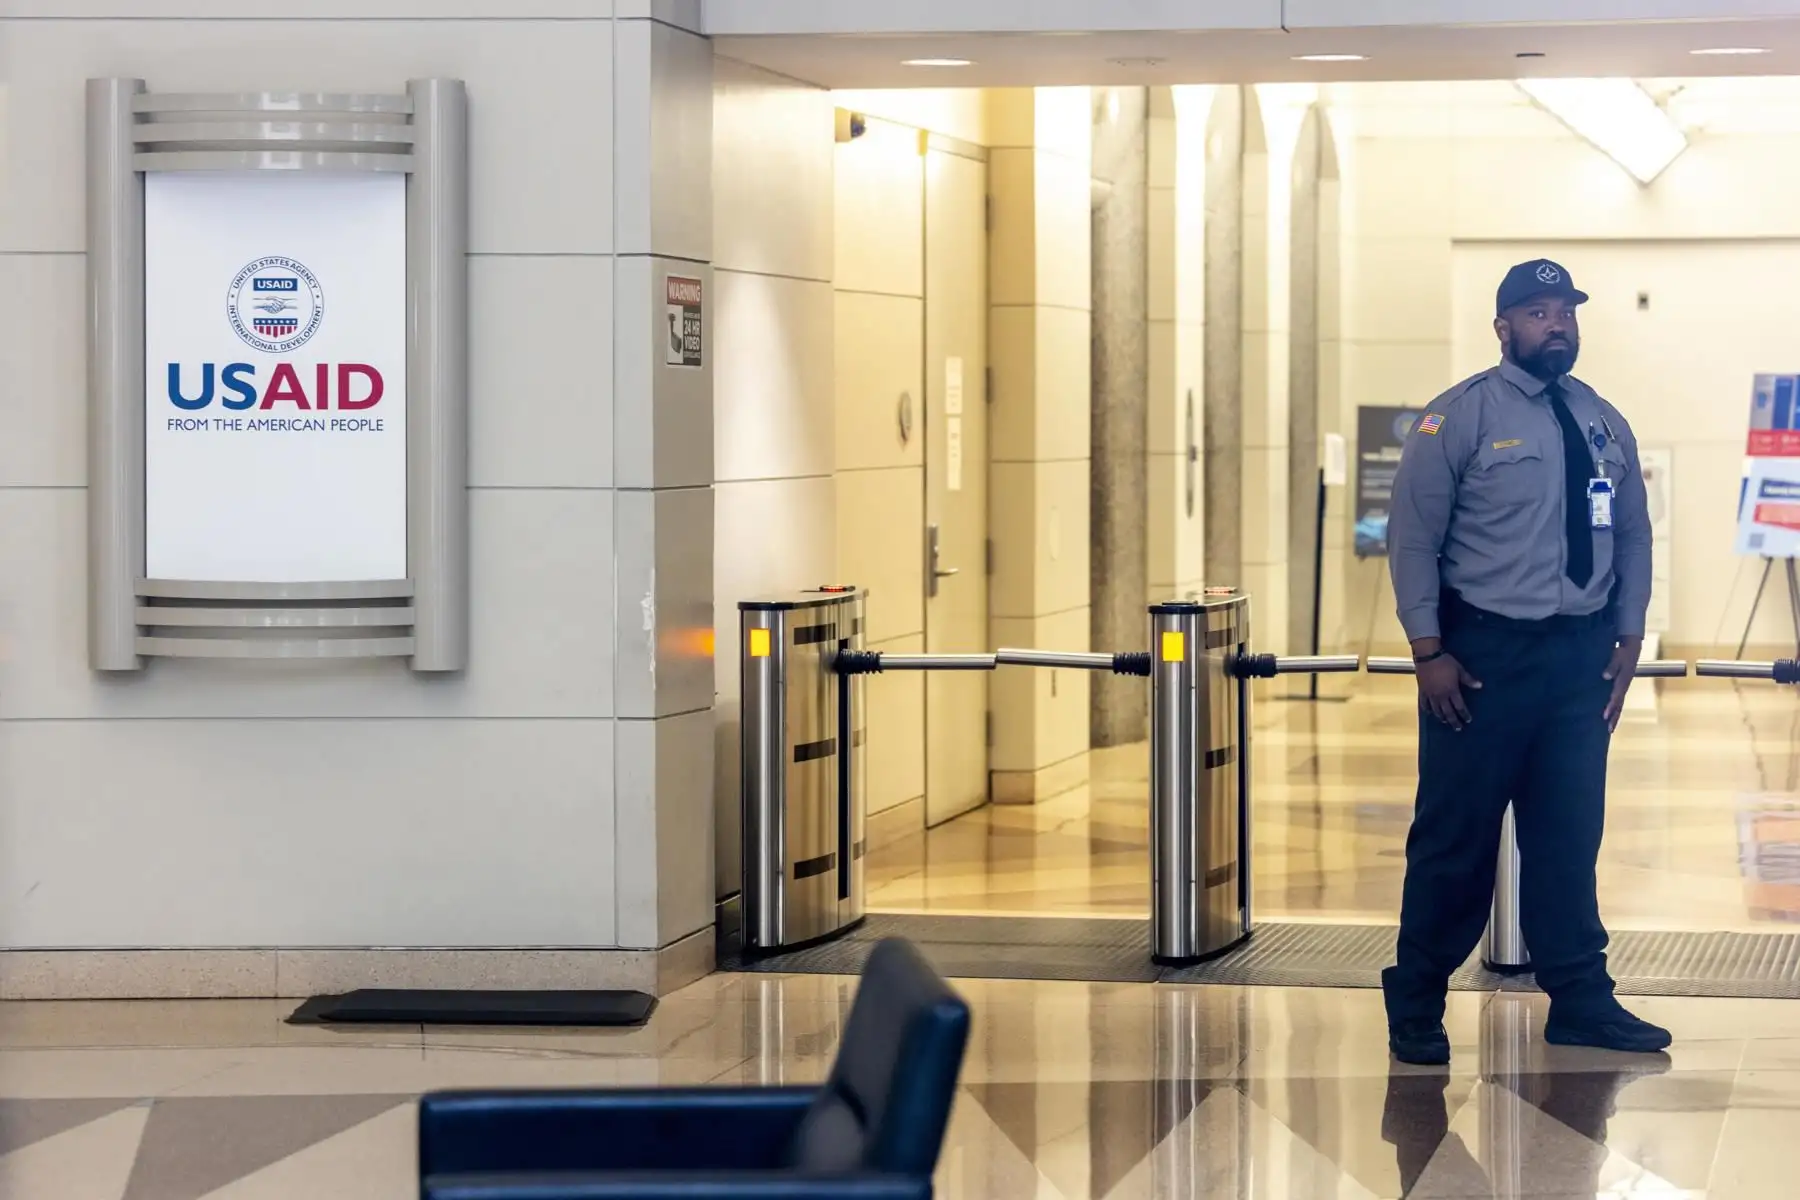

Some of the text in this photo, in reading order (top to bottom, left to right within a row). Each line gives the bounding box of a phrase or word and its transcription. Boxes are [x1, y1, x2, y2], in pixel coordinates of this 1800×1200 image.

[232, 258, 318, 289] UNITED STATES AGENCY
[257, 280, 293, 289] USAID
[668, 281, 701, 302] WARNING
[229, 304, 321, 351] INTERNATIONAL DEVELOPMENT
[168, 363, 384, 410] USAID
[167, 419, 384, 431] FROM THE AMERICAN PEOPLE
